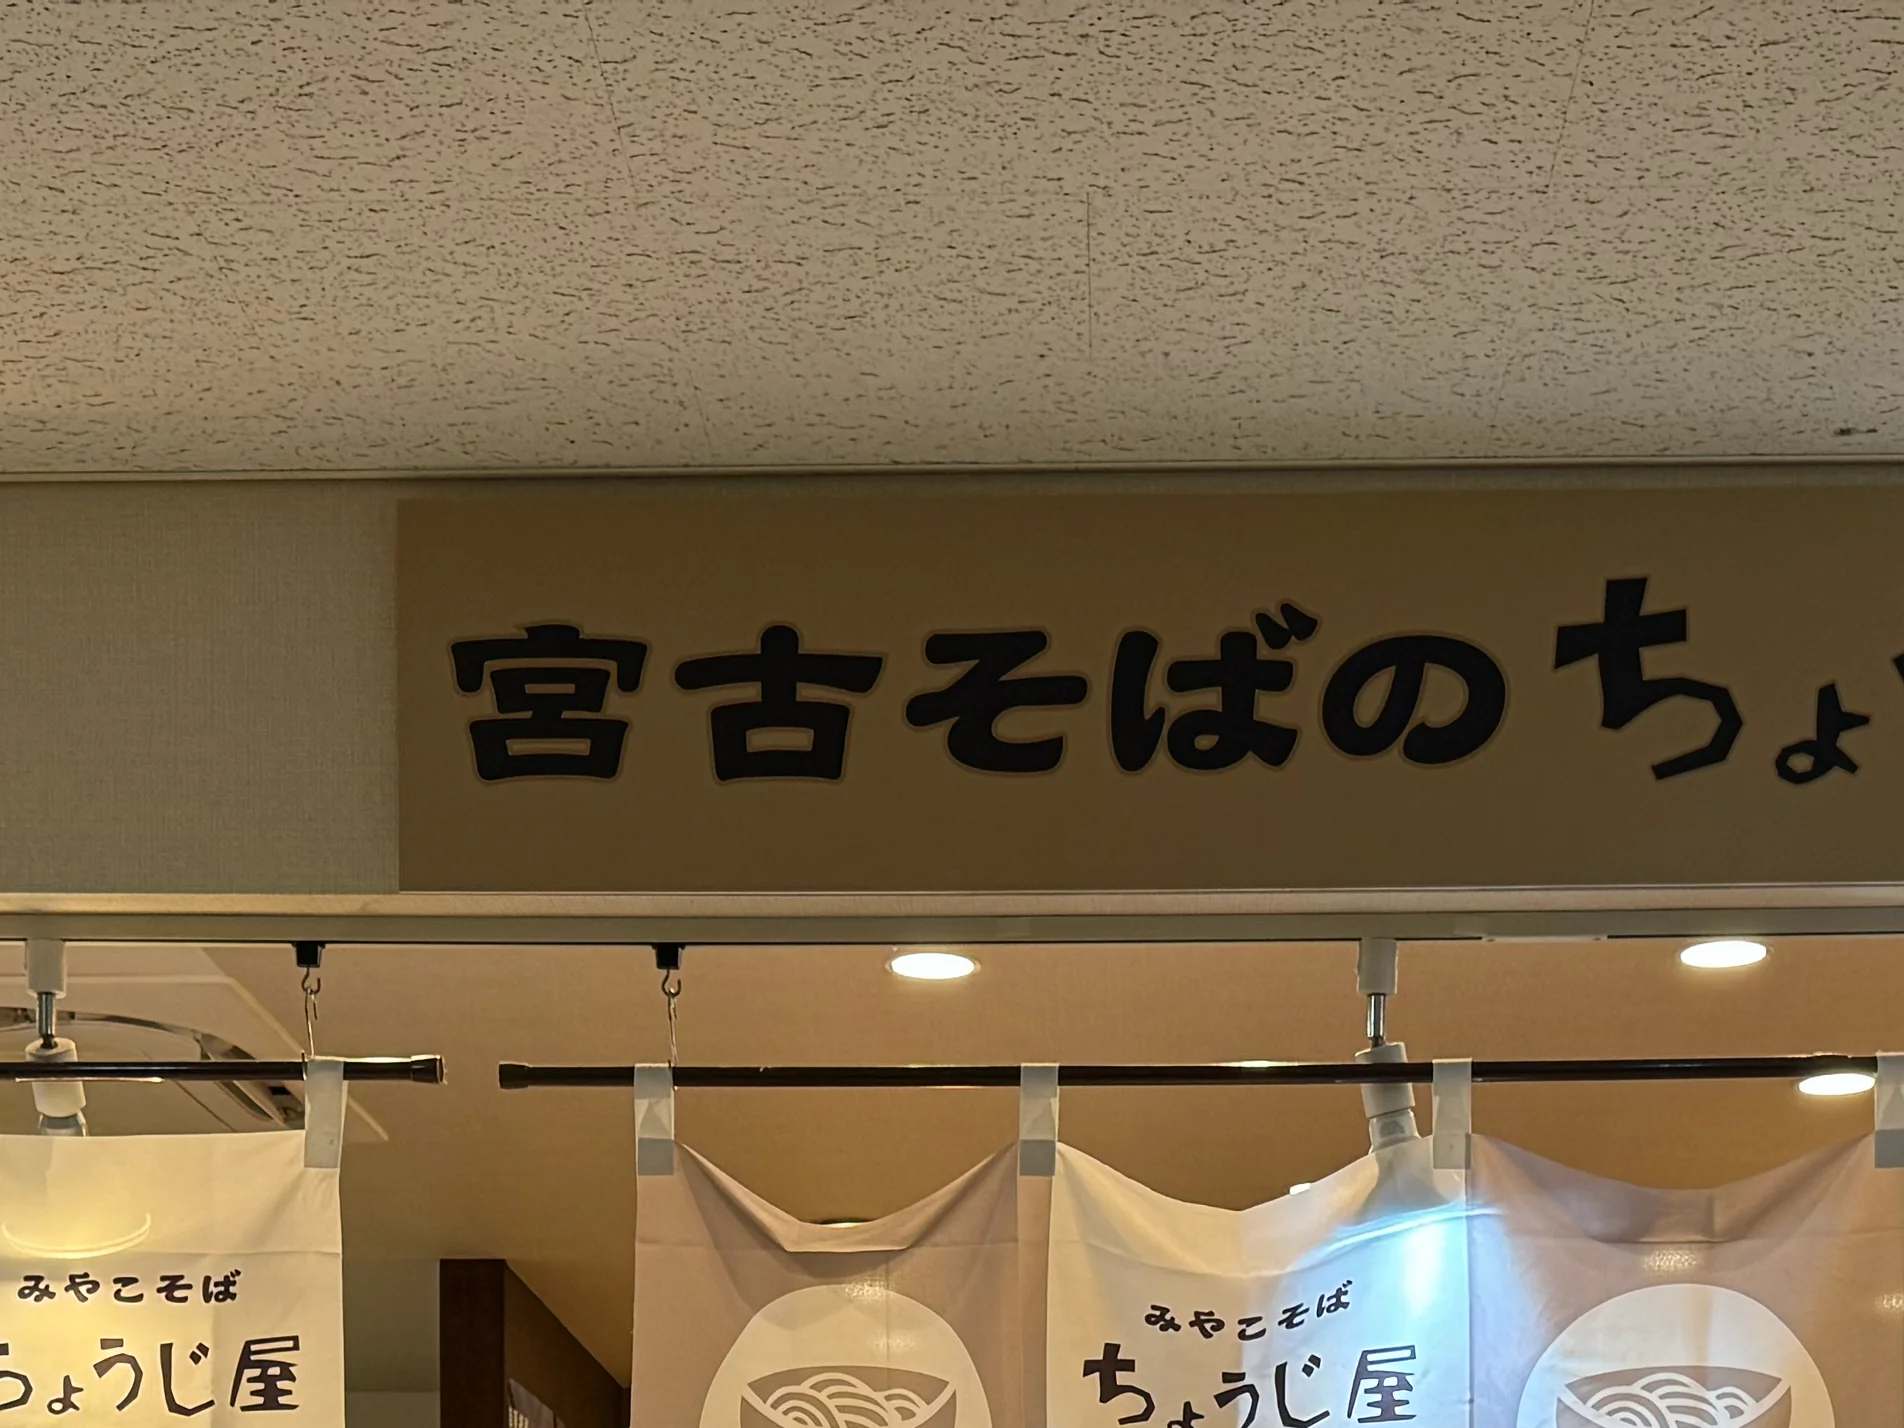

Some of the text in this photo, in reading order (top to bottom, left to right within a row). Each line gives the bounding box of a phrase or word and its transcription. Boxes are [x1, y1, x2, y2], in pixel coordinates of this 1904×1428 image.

[16, 1267, 240, 1306] みやこそば
[1142, 1278, 1351, 1342] みやこそば
